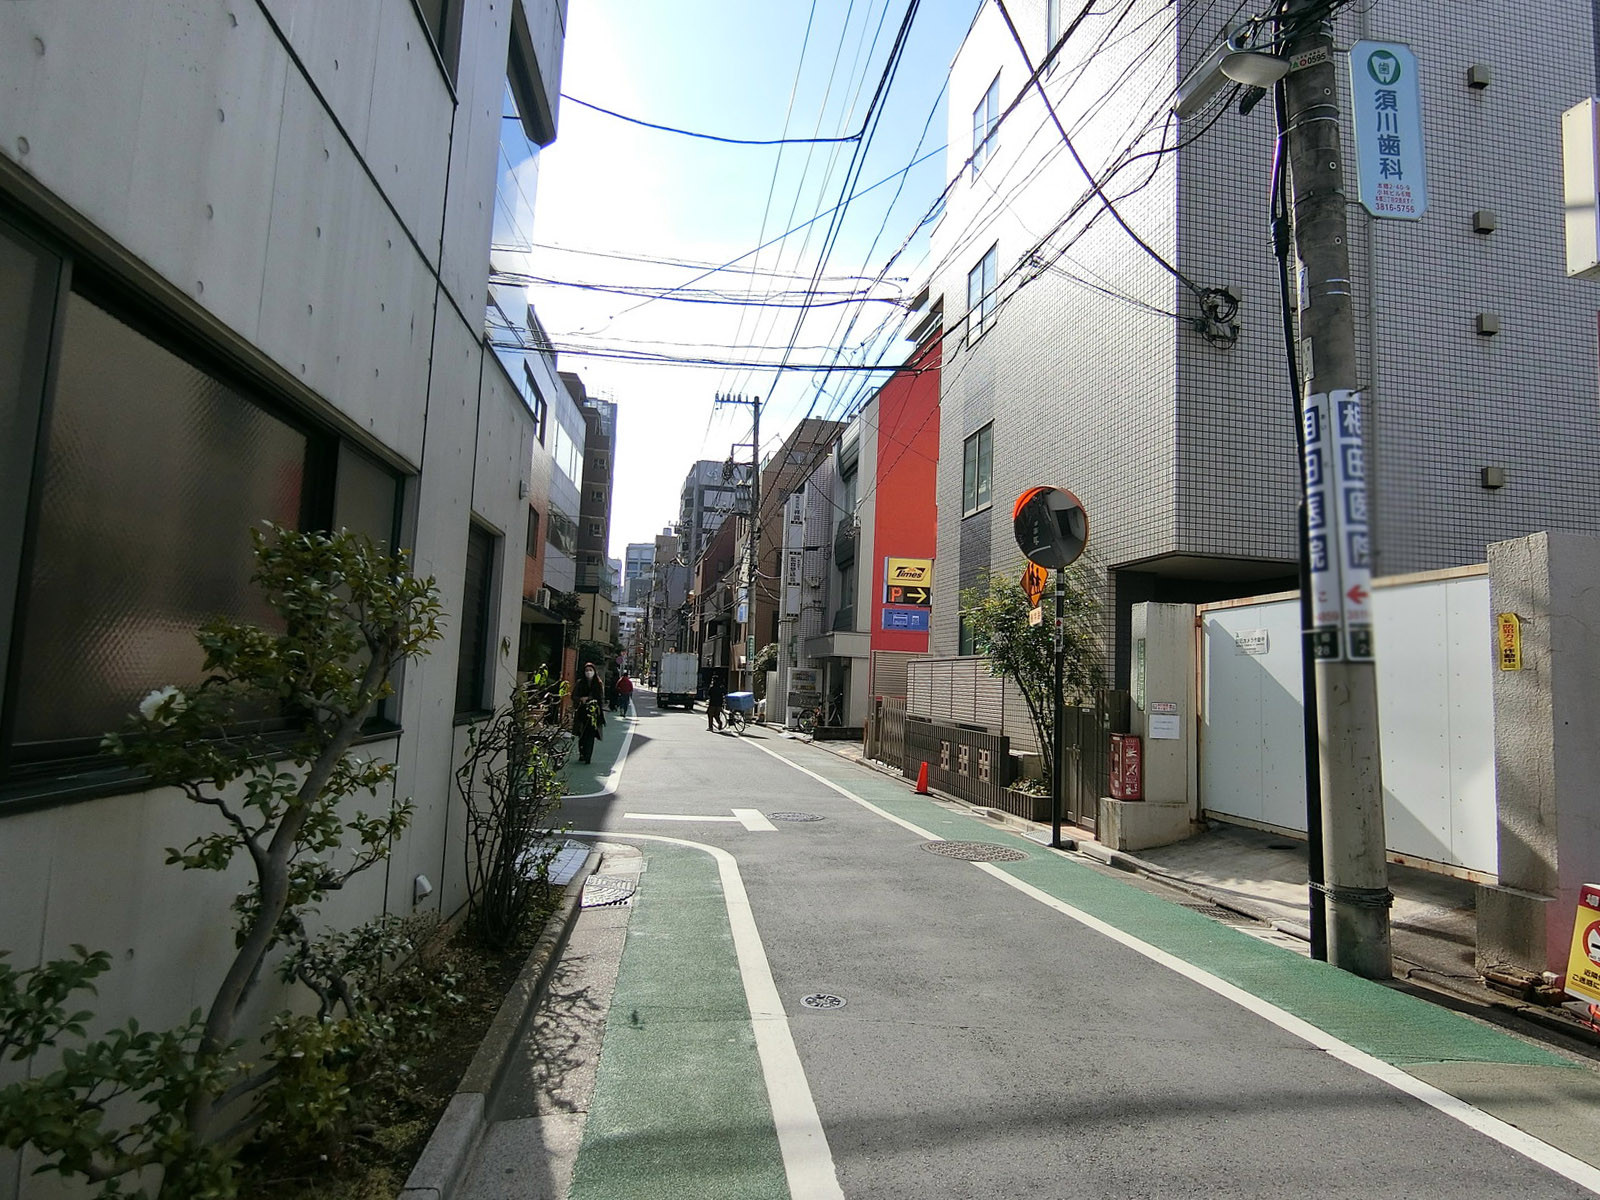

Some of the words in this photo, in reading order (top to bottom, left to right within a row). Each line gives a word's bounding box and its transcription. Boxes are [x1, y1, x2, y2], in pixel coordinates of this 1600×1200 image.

[1307, 52, 1326, 64] 0595
[1378, 62, 1390, 75] 歯
[1374, 88, 1404, 181] 須川歯科
[895, 566, 926, 579] Times
[890, 587, 902, 602] P
